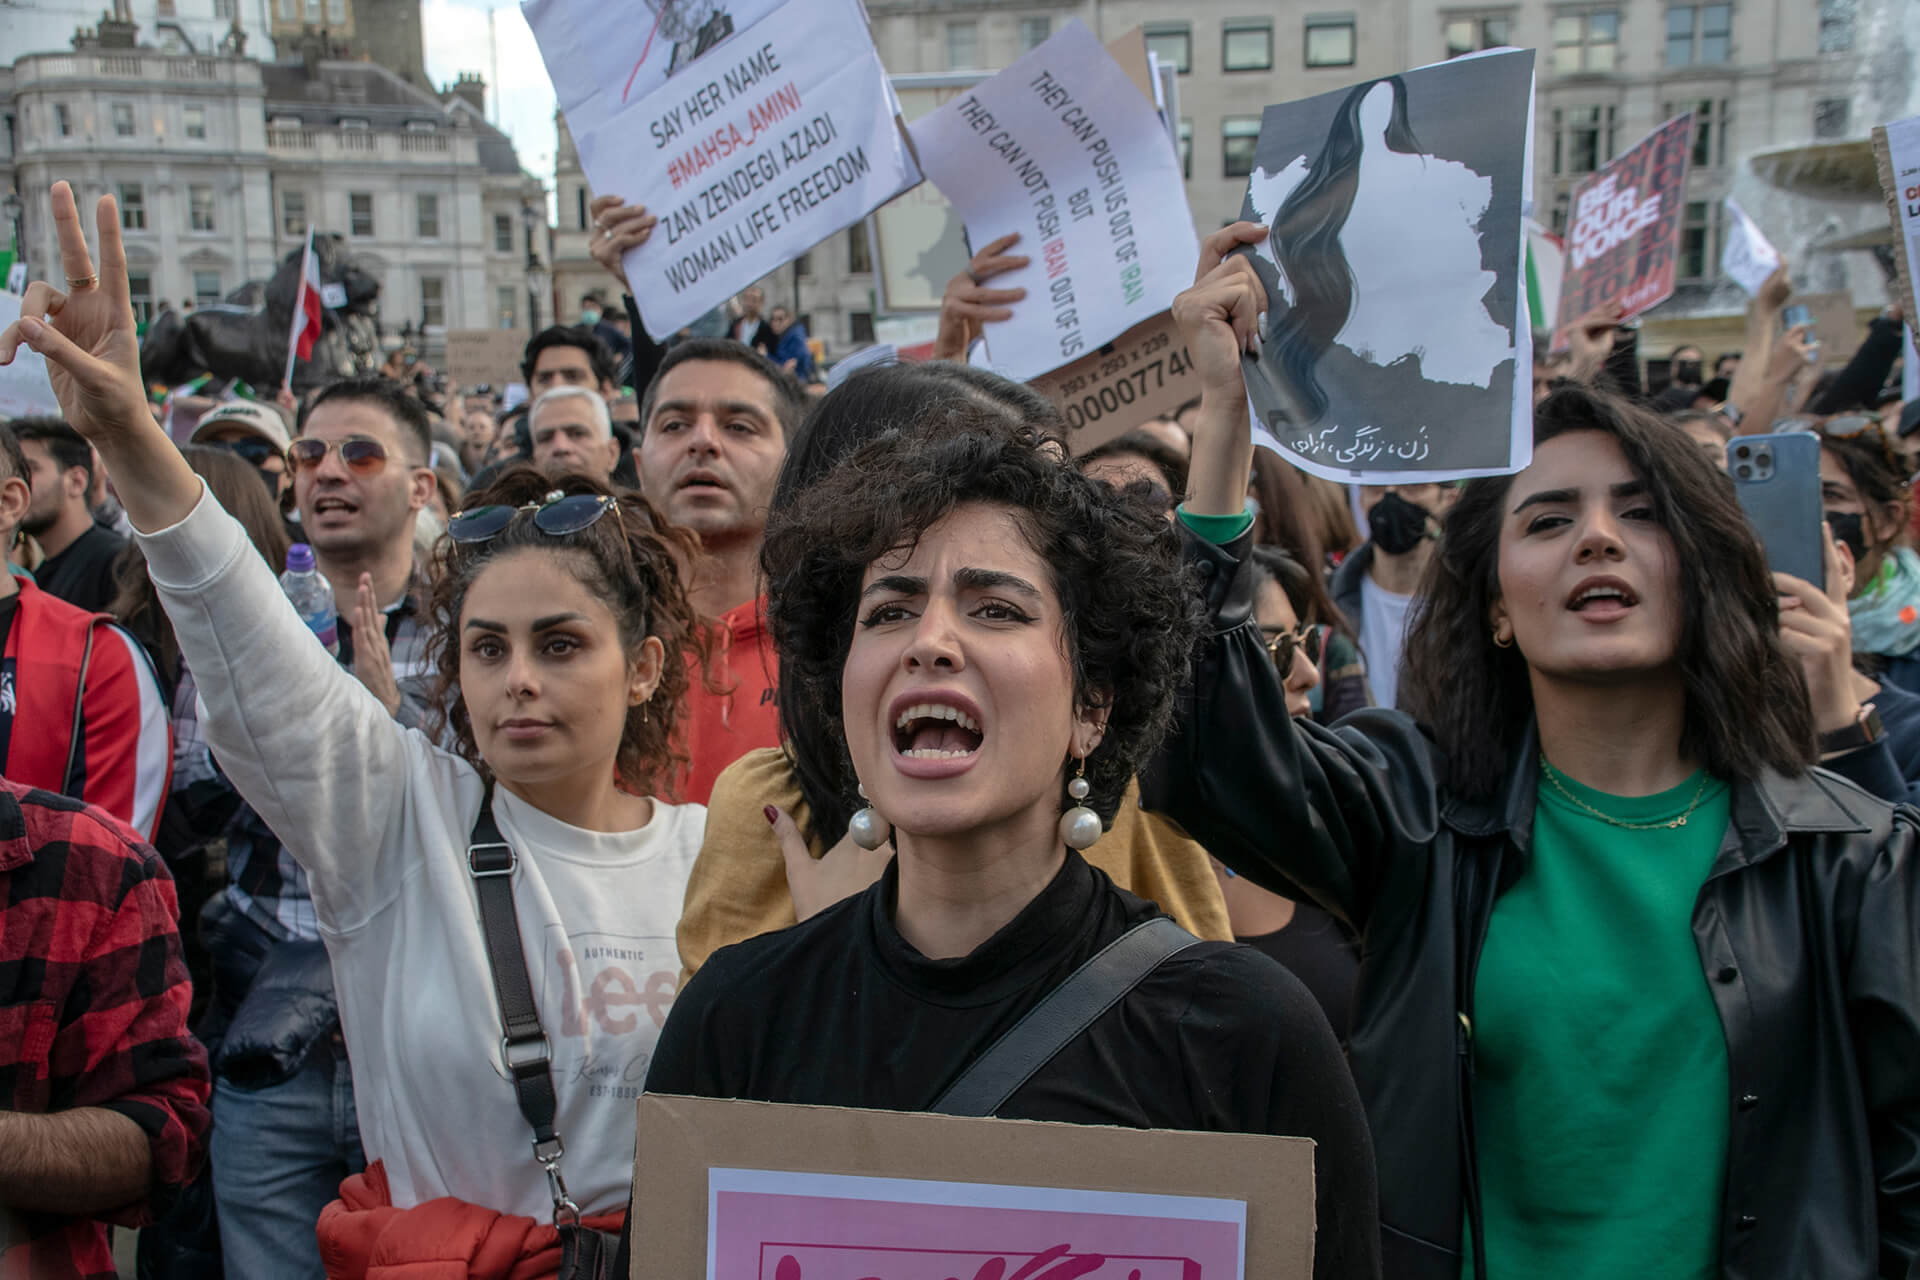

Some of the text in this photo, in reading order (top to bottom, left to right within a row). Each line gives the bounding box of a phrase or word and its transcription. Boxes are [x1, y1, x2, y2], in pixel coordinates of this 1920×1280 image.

[650, 42, 781, 149] SAY HER NAME
[667, 81, 802, 190] #MAHSA_AMINI
[661, 111, 838, 246] ZAN ZENDEGI AZADI
[664, 145, 871, 294] WOMAN LIFE FREEDOM
[1030, 70, 1144, 306] THEY CAN PUSH US OUT OF IRAN
[1067, 187, 1095, 223] BUT
[1573, 186, 1637, 245] OUR
[1576, 172, 1618, 219] BE
[957, 95, 1084, 358] THEY CAN NOT PUSH IRAN OUT OF US
[1572, 193, 1662, 270] VOICE
[1066, 345, 1194, 430] 0000774
[1088, 372, 1098, 384] x
[1130, 350, 1140, 361] x
[556, 948, 680, 1037] Lee
[584, 947, 645, 961] AUTHENTIC
[623, 1052, 650, 1082] C
